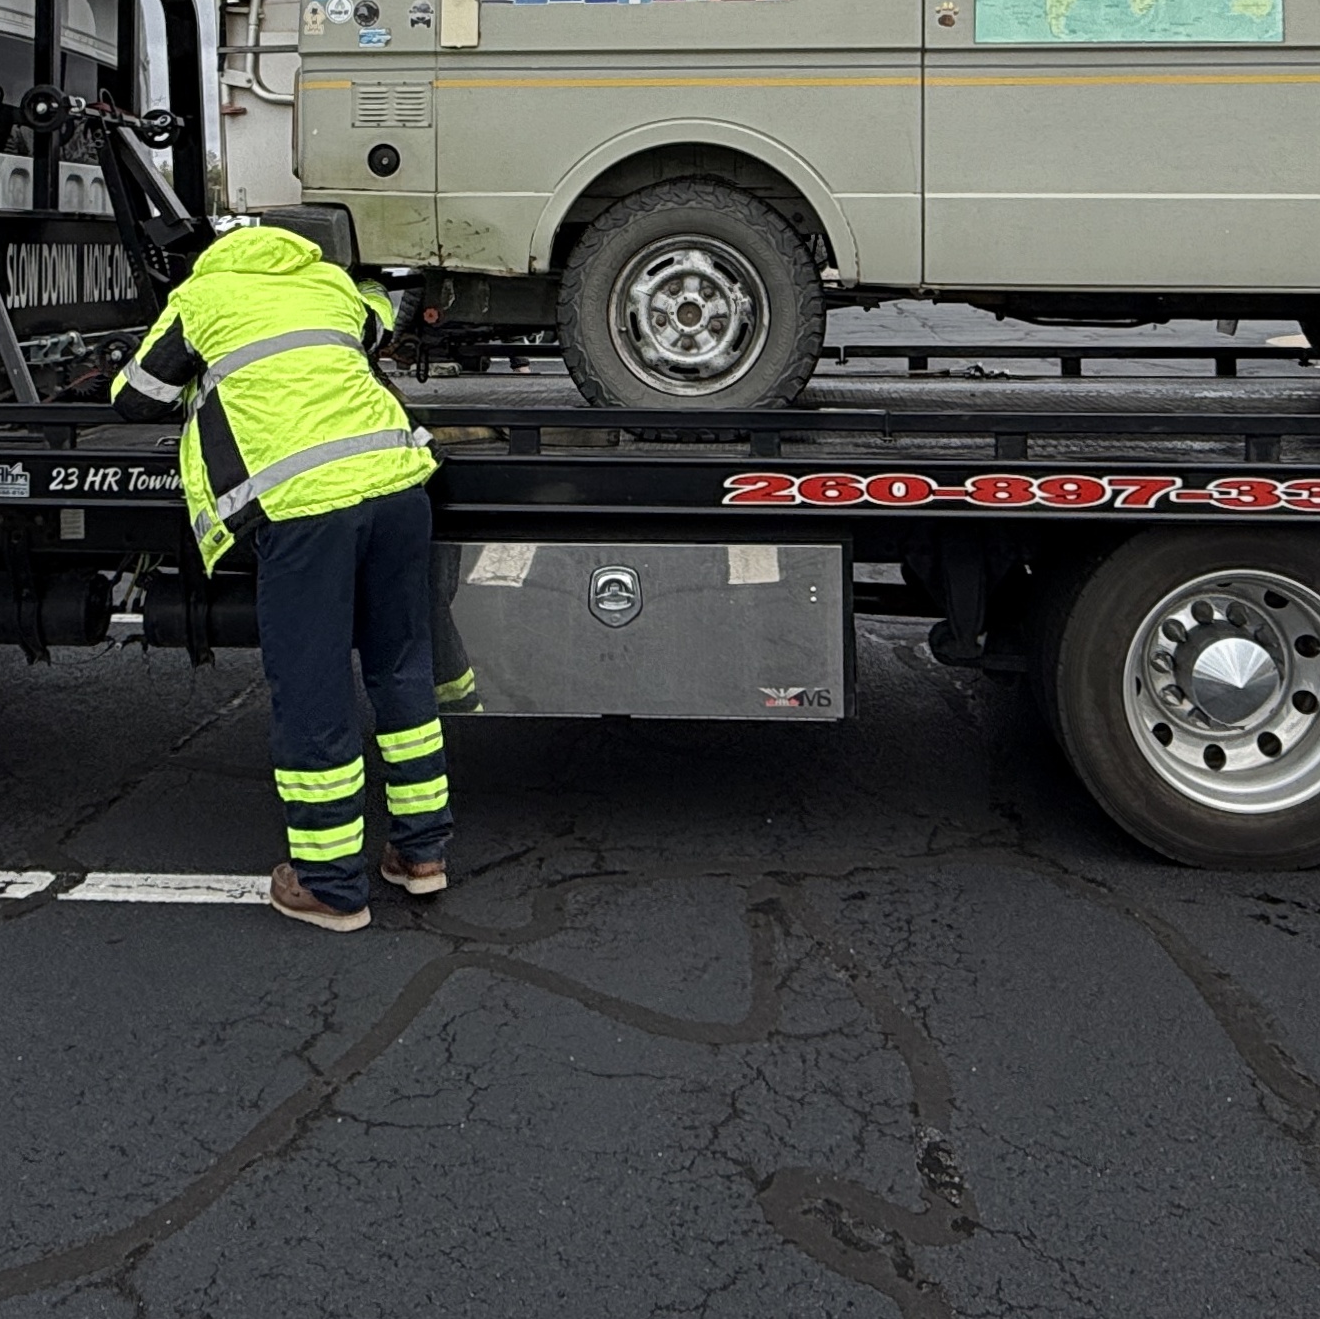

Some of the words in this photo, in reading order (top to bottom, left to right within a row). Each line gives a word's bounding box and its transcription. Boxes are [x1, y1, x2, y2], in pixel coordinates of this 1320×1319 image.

[6, 243, 40, 309] SLOW
[42, 243, 77, 306] DOWN
[83, 243, 111, 303] MOVE
[113, 243, 138, 300] OVE
[49, 467, 79, 491] 23
[83, 467, 122, 492] HR
[128, 467, 184, 492] Towin
